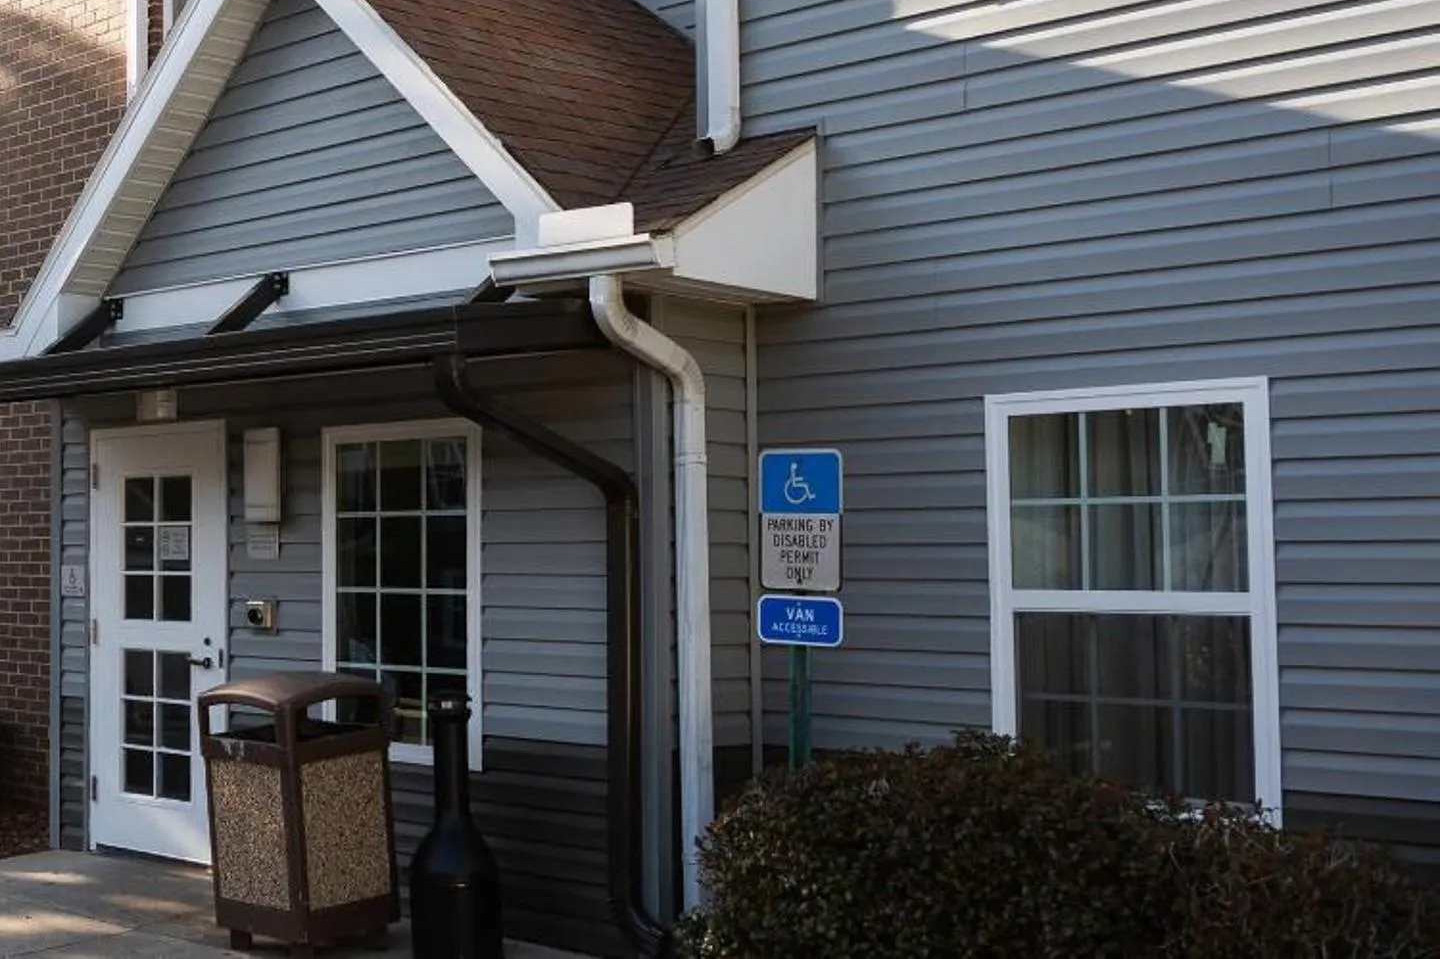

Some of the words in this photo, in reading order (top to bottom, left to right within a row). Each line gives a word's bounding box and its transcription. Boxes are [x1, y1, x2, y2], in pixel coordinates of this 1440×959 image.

[767, 519, 813, 532] PARKING
[819, 519, 834, 532] BY
[773, 534, 827, 548] DISABLED
[781, 550, 819, 564] PERMIT
[786, 566, 814, 580] ONLY
[786, 607, 815, 622] VAN
[771, 622, 828, 635] ACCESSIBLE
